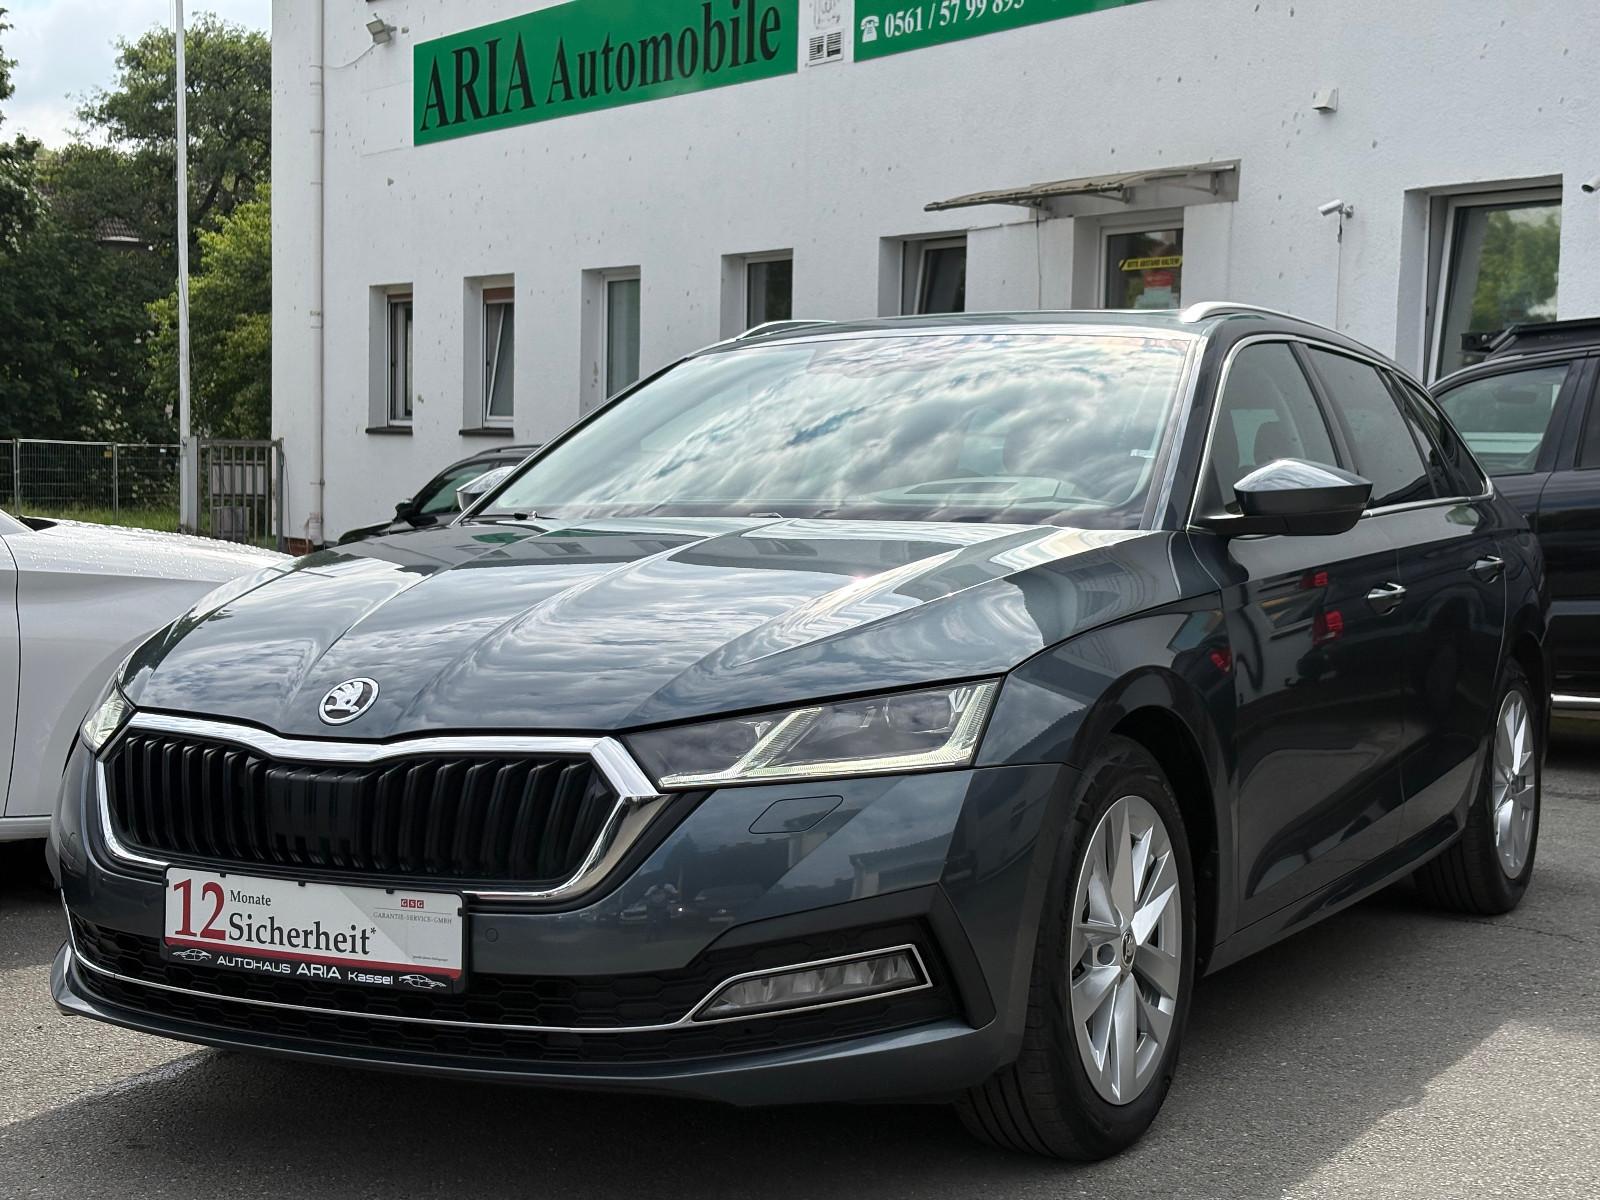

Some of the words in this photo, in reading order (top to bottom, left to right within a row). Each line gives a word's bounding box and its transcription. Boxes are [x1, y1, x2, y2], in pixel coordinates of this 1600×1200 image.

[884, 6, 923, 38] 0561
[928, 3, 936, 29] /
[939, 0, 960, 26] 57
[420, 31, 536, 132] ARIA
[545, 0, 781, 104] Automobile
[173, 878, 227, 941] 12
[230, 889, 272, 906] Monate
[401, 899, 424, 909] GSG
[216, 955, 291, 974] AUTOHAUS
[296, 962, 342, 980] ARIA
[348, 971, 394, 985] Kassel
